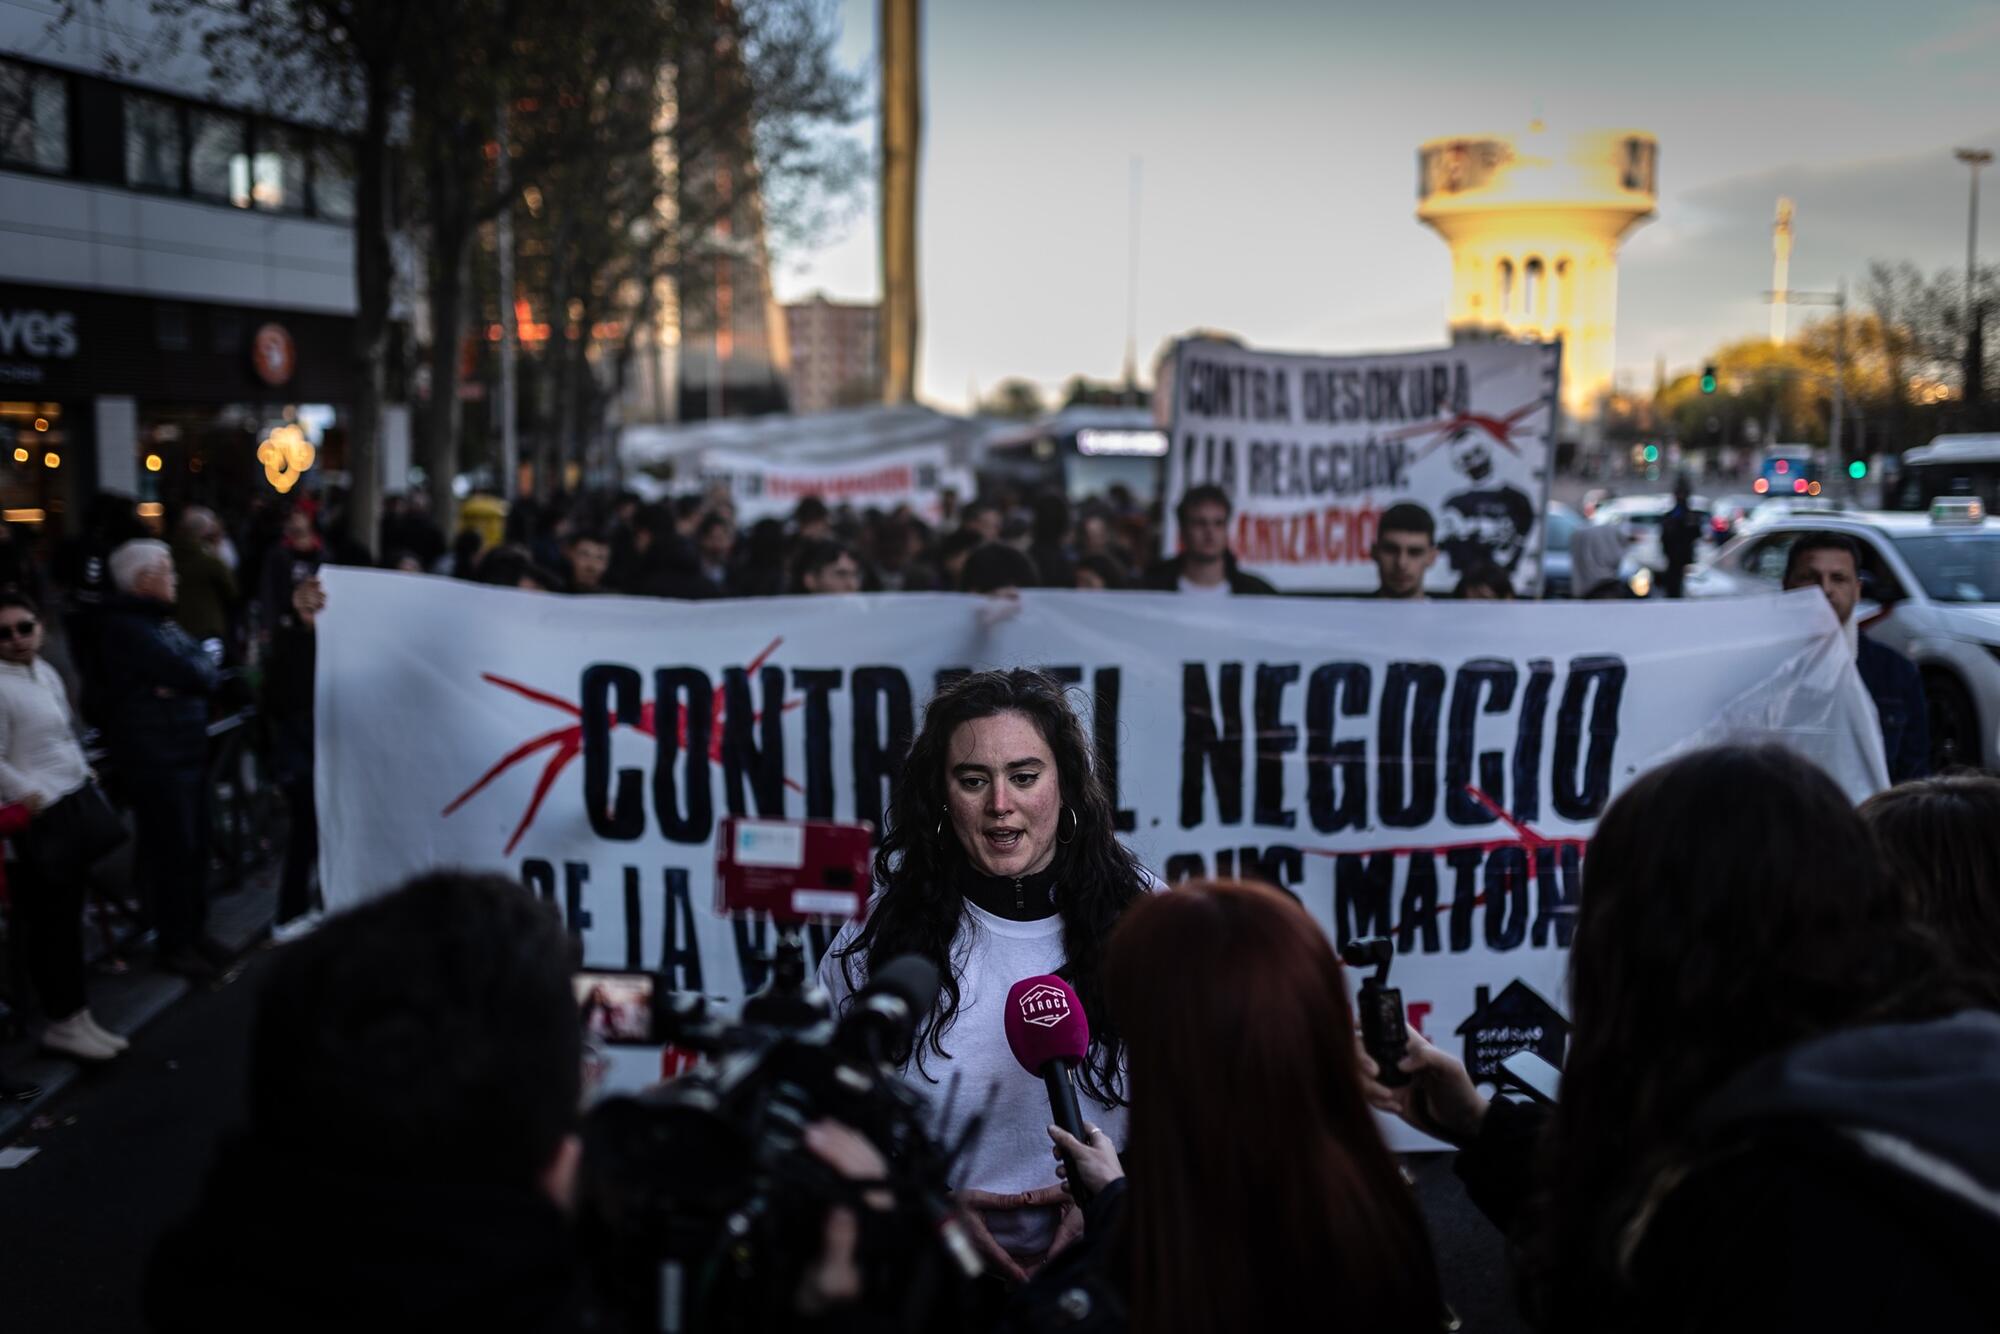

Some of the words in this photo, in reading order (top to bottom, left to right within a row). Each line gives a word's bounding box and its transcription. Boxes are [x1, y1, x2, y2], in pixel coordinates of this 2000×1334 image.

[1187, 359, 1290, 420] CONTRA
[580, 664, 980, 842] CONTR
[1036, 665, 1136, 834] L
[1178, 654, 1627, 834] NEGOCIO
[1336, 844, 1580, 956] MATON
